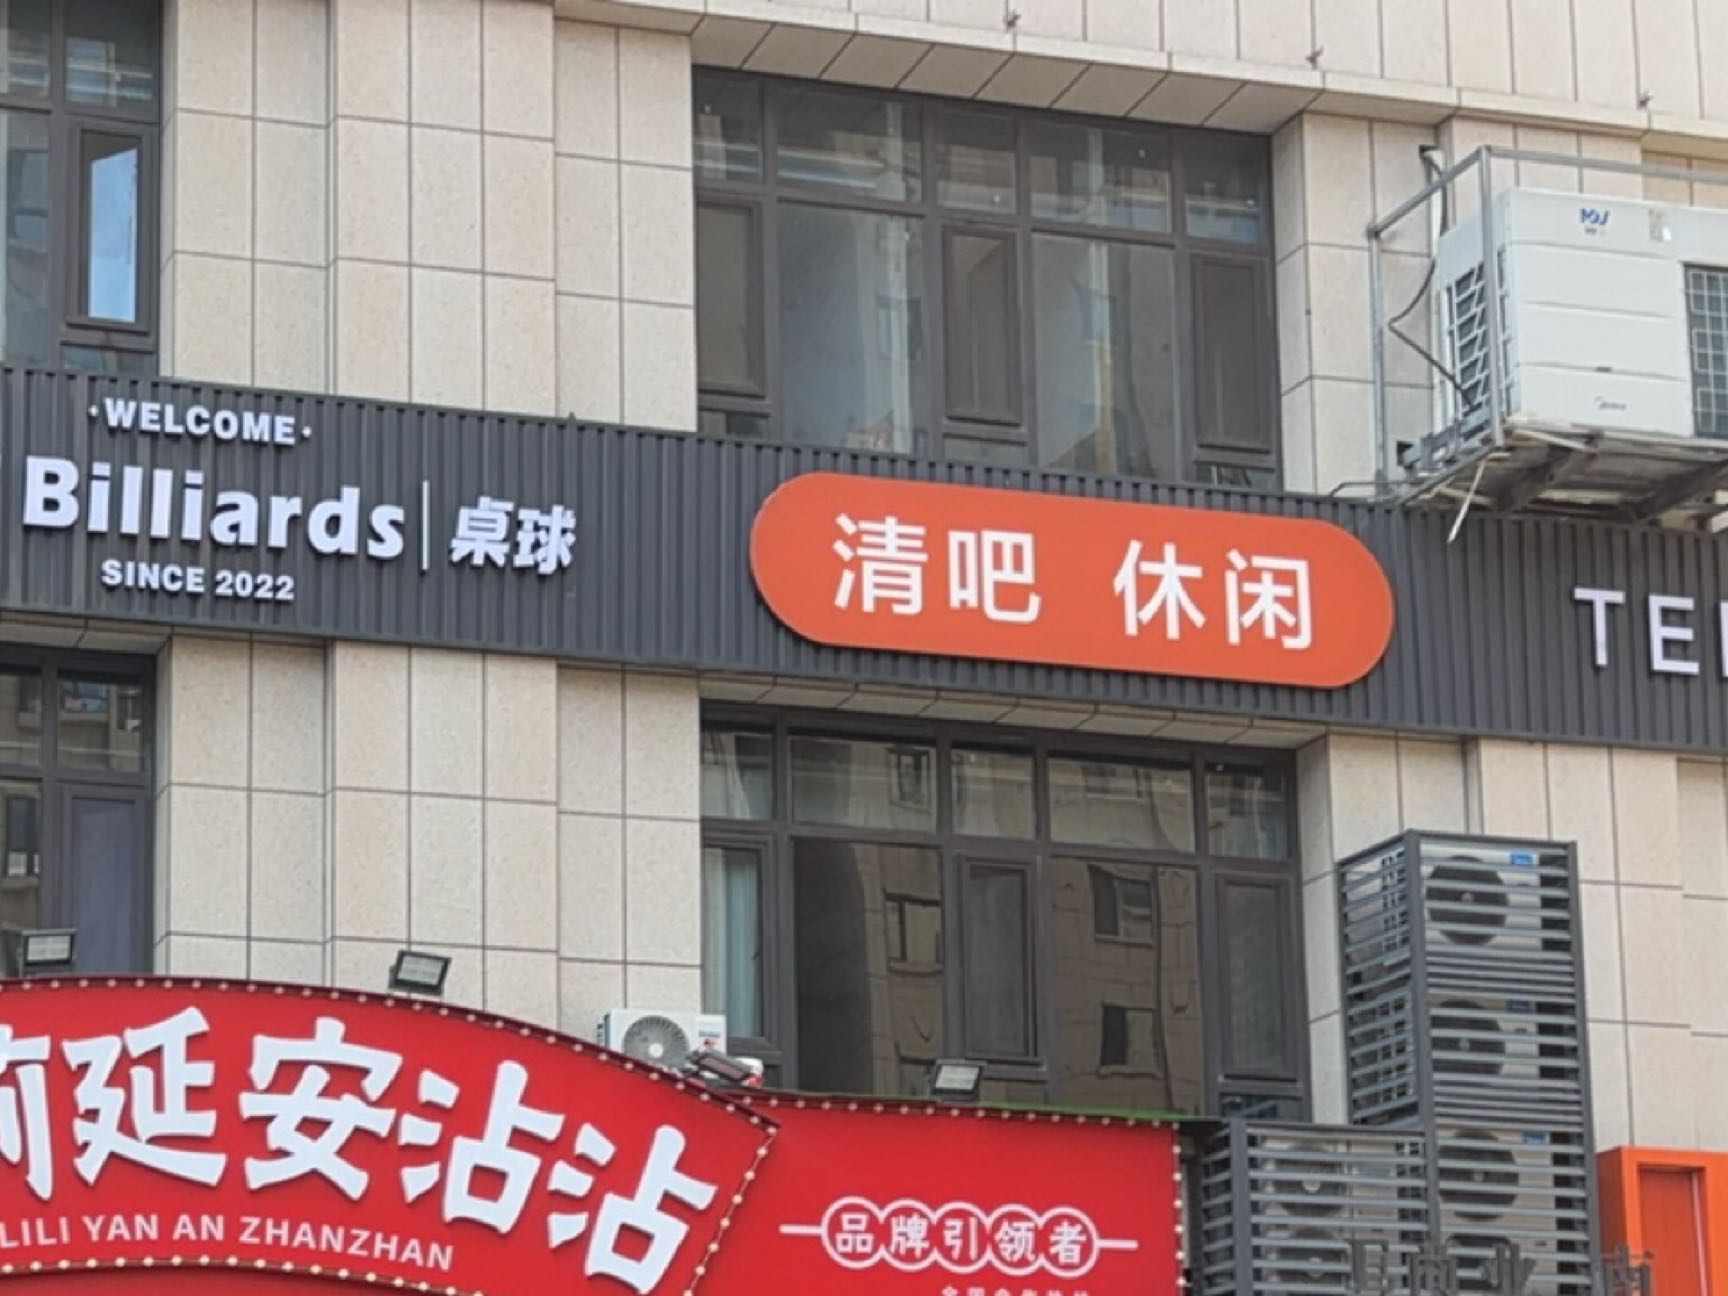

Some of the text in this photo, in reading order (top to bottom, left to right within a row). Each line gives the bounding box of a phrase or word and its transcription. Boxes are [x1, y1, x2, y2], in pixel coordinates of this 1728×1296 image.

[22, 455, 406, 560] Billiards
[449, 496, 578, 575] 桌球
[101, 559, 295, 601] SINCE 2022
[832, 512, 1313, 650] 清吧 休闲
[1574, 587, 1728, 678] TE
[83, 1214, 160, 1242] YAN
[171, 1214, 225, 1242] AN
[238, 1217, 455, 1273] ZHANZHAN
[834, 1211, 1088, 1267] 品牌引领者
